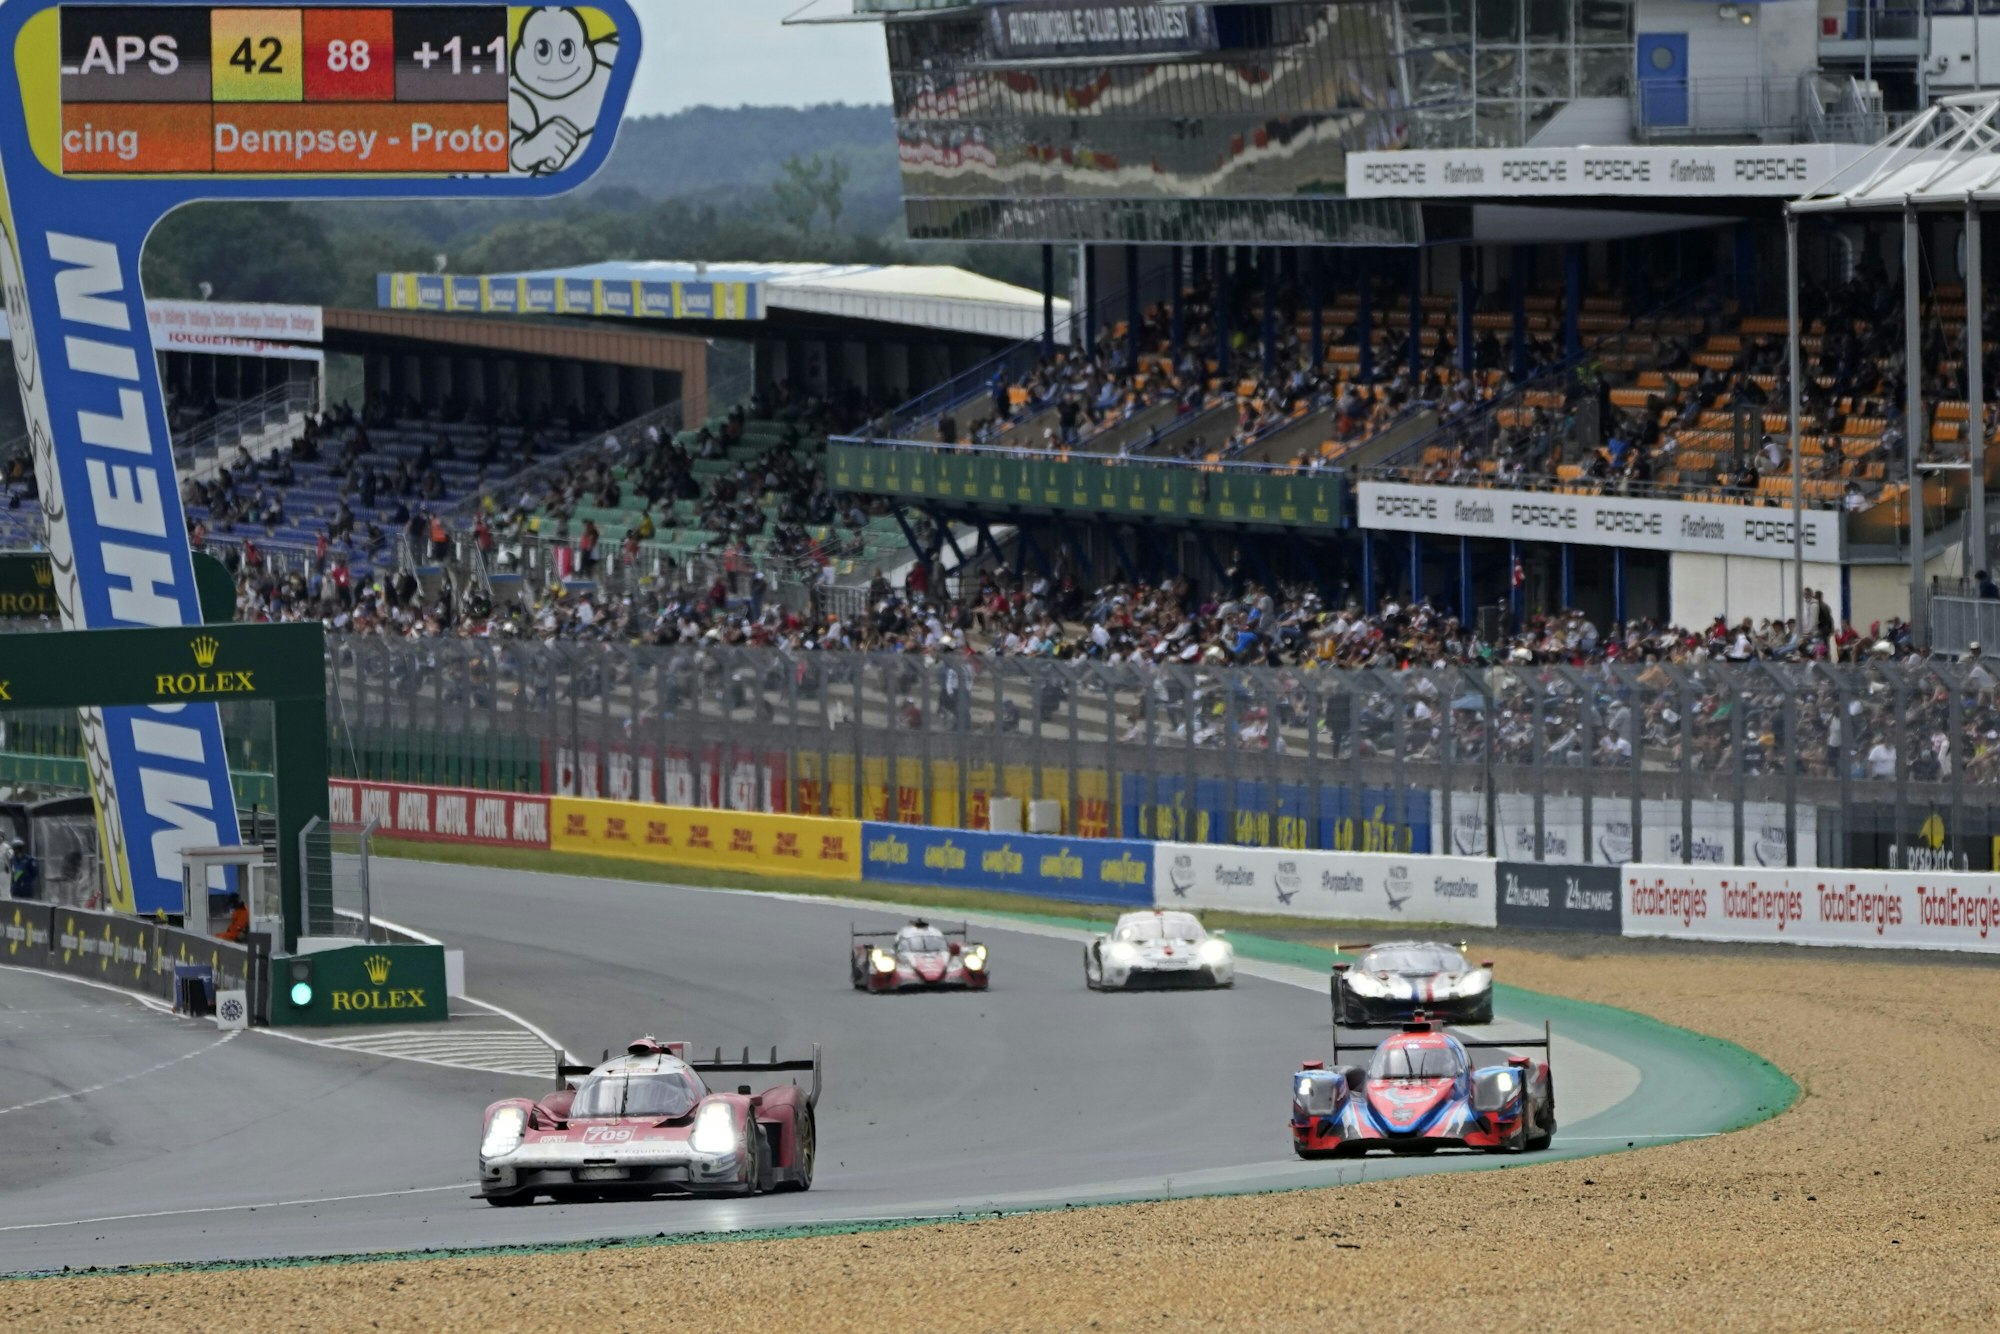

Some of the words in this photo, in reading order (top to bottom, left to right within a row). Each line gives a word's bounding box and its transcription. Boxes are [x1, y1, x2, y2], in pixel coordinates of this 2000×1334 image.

[1008, 9, 1086, 45] AUTOMOBILE
[1087, 7, 1119, 42] CLUB
[1120, 6, 1139, 40] DE
[229, 37, 283, 74] 42
[327, 39, 371, 72] 88
[413, 36, 505, 75] +1:1
[62, 123, 138, 160] cing
[214, 123, 378, 160] Dempsey
[411, 122, 505, 152] Proto
[1364, 163, 1426, 184] PORSCHE
[1502, 160, 1567, 182] PORSCHE
[1584, 160, 1650, 182] PORSCHE
[1735, 158, 1807, 180] PORSCHE
[1377, 496, 1437, 519] PORSCHE
[1454, 500, 1495, 523] #TeamPorsche
[1511, 504, 1577, 529] PORSCHE
[1595, 510, 1662, 535] PORSCHE
[1681, 514, 1725, 540] #TeamPorsche
[46, 231, 227, 891] MIHELIN
[155, 671, 256, 695] ROLEX
[361, 789, 392, 829] MOTUL
[398, 792, 430, 832] MOTUL
[435, 795, 468, 836] MOTUL
[474, 798, 507, 840] MOTUL
[513, 801, 547, 843] MOTUL
[1629, 878, 1707, 928] TotalEnergies
[1720, 880, 1803, 931] TotalEnergies
[1817, 883, 1903, 935] TotalEnergies
[331, 989, 427, 1010] ROLEX
[589, 1129, 631, 1141] 709
